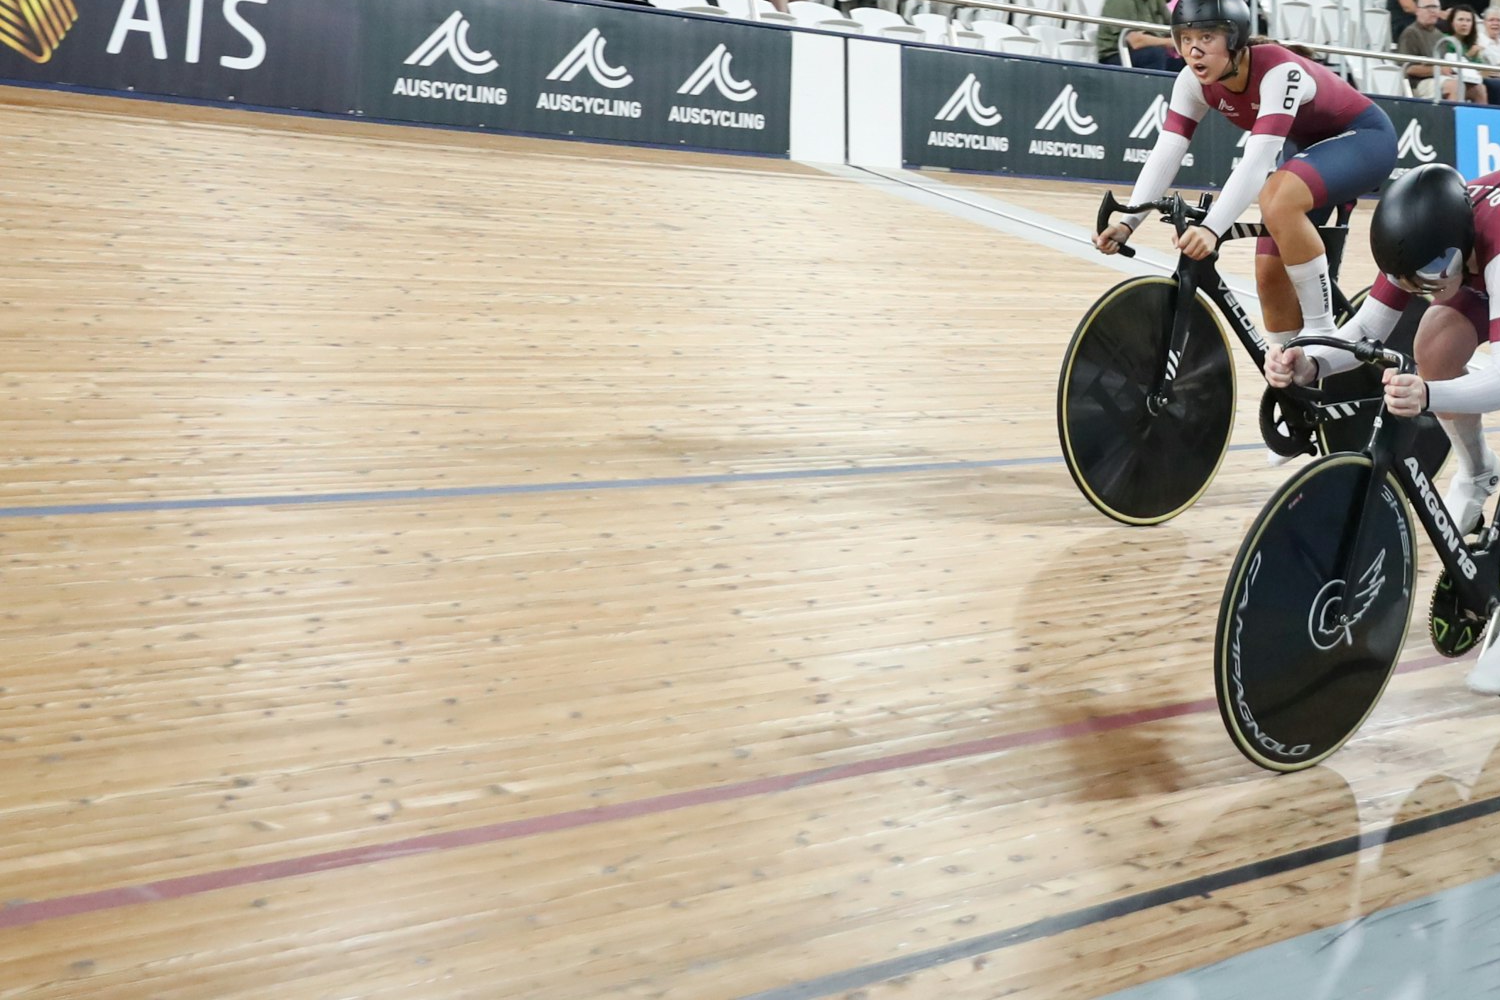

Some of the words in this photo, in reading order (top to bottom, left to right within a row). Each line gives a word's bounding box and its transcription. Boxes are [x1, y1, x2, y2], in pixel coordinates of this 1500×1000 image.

[393, 77, 507, 105] AUSCYCLING
[1283, 70, 1301, 110] QLD
[536, 92, 642, 118] AUSCYCLING
[668, 105, 765, 130] AUSCYCLING
[928, 131, 1009, 152] AUSCYCLING
[1029, 139, 1105, 160] AUSCYCLING
[1404, 457, 1459, 552] ARGON
[1457, 548, 1477, 580] 18
[1232, 550, 1311, 756] CAMPAGNOLO
